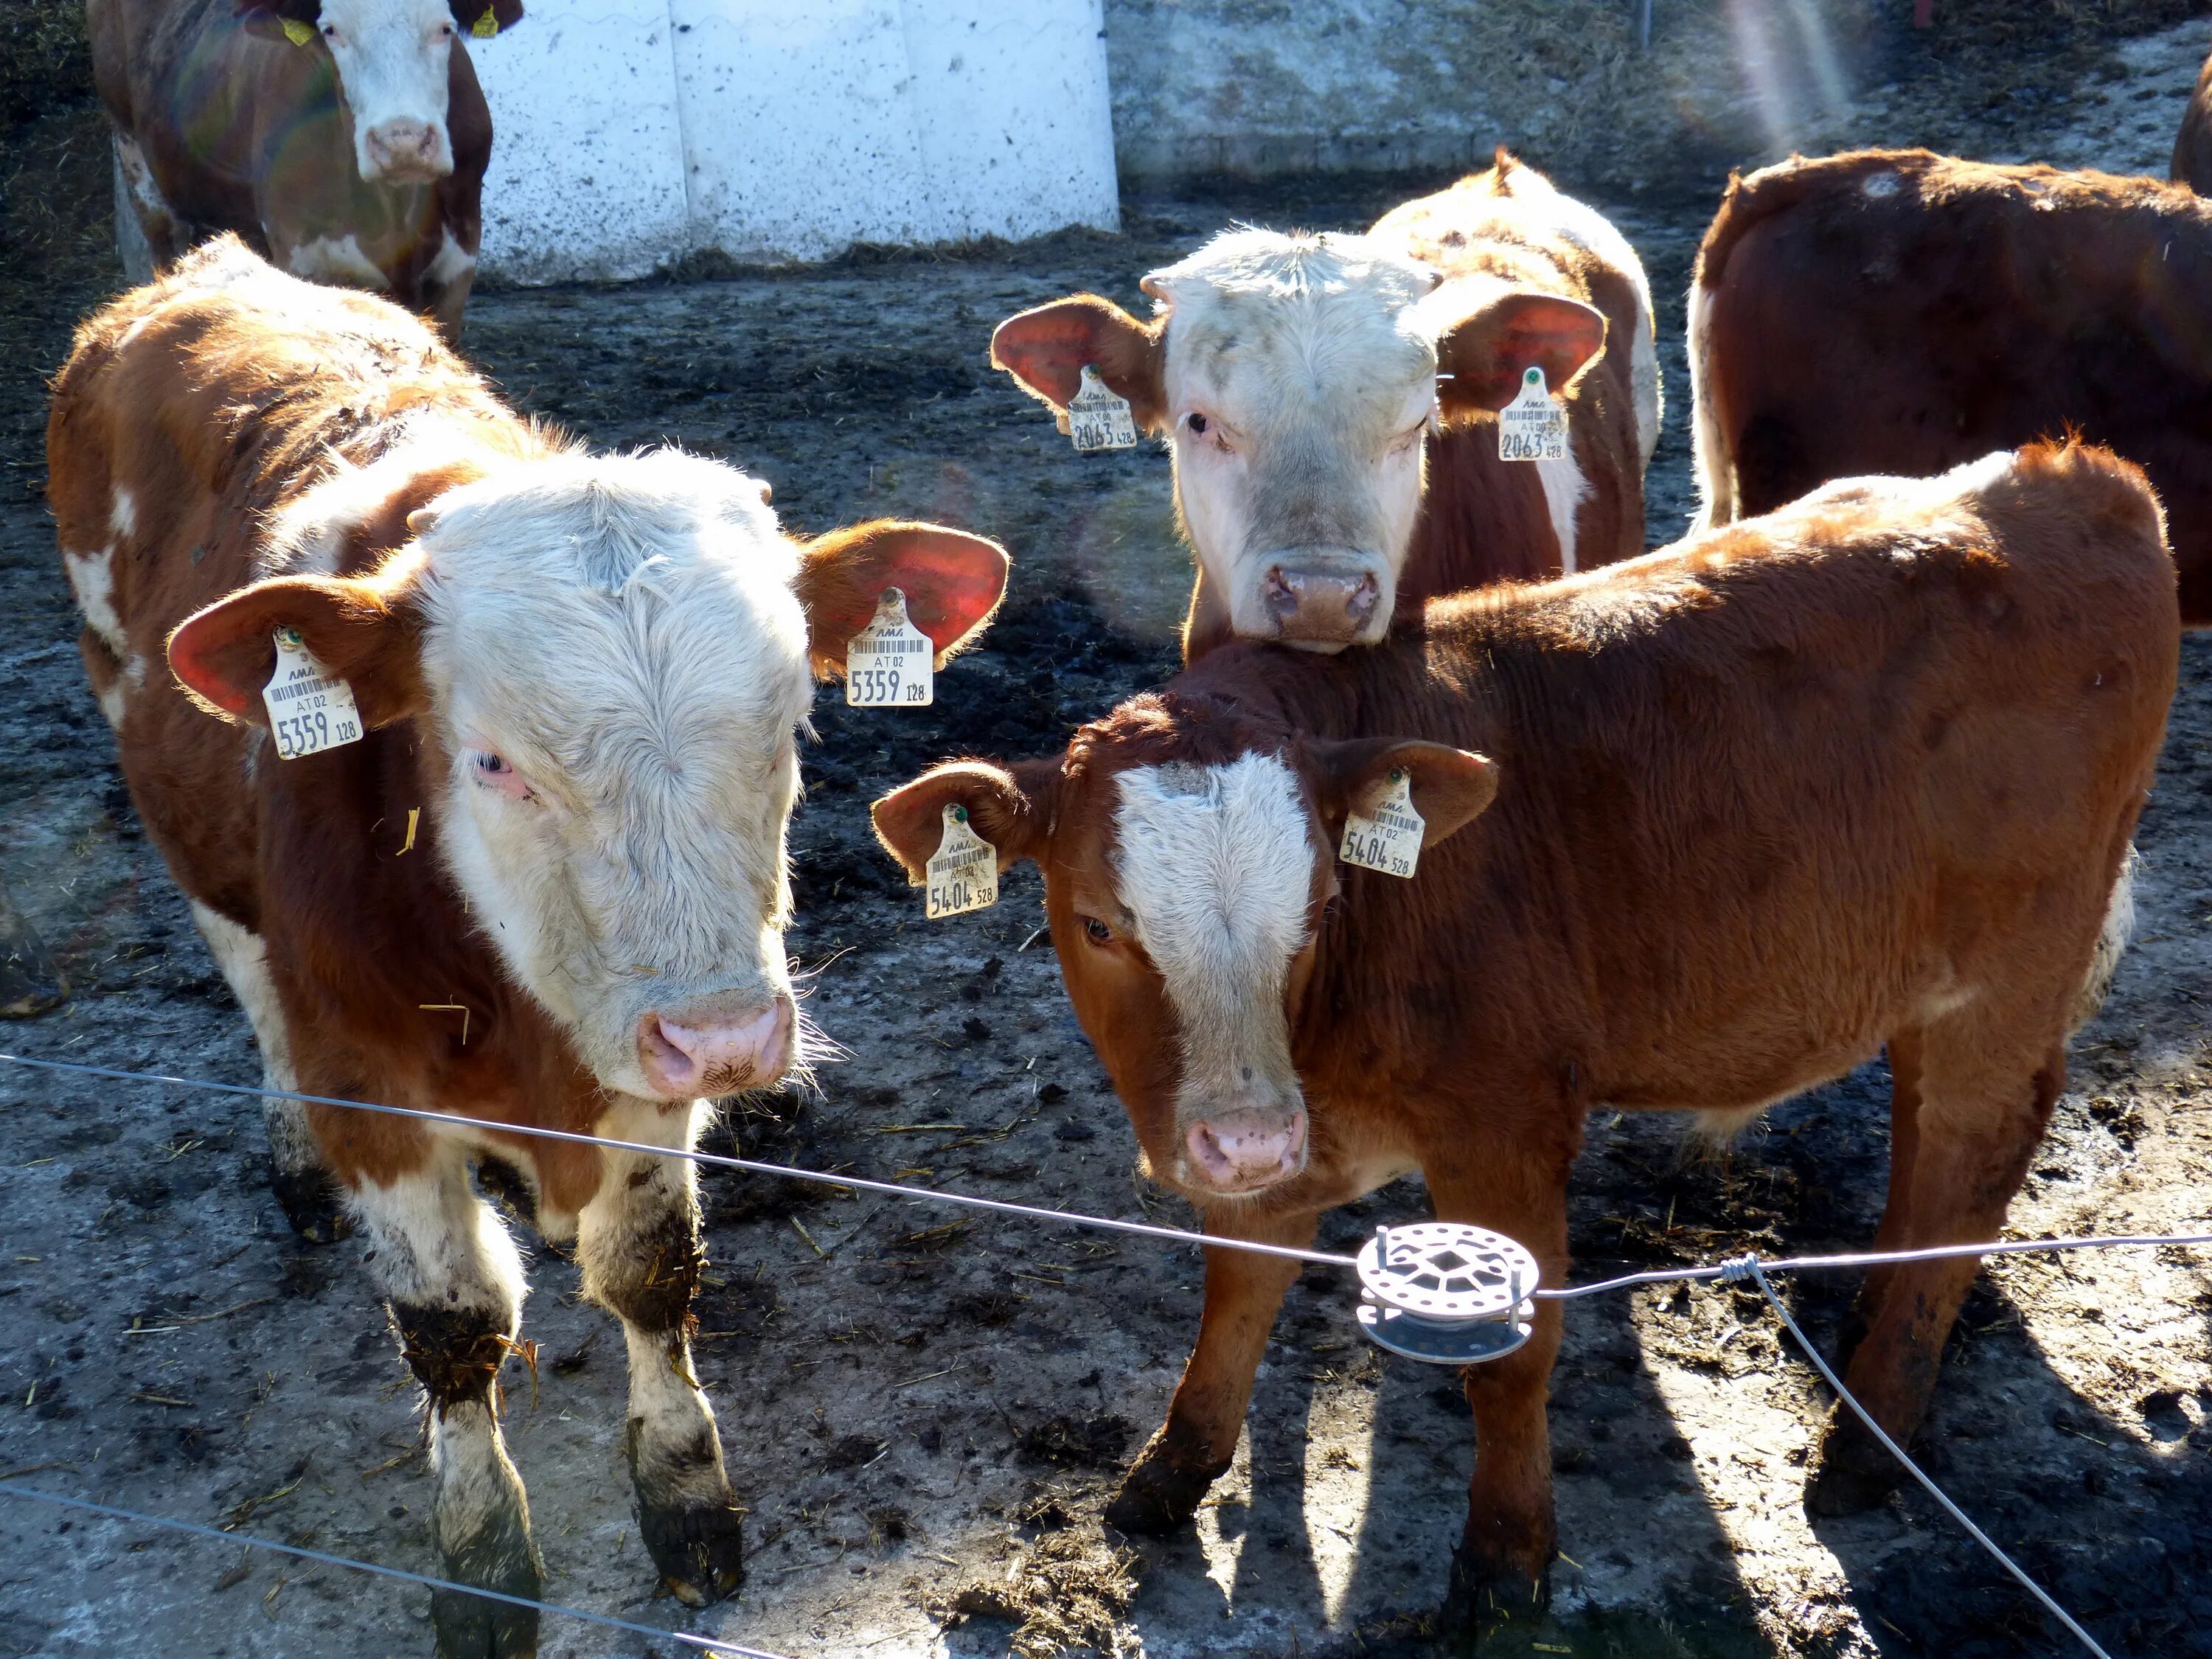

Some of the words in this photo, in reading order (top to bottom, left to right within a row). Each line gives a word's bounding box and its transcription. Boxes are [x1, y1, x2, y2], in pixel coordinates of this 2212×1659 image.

[1075, 422, 1113, 448] 2063
[1503, 434, 1542, 458] 2063
[874, 656, 891, 667] AT
[894, 656, 903, 667] 02
[852, 670, 900, 702] 5359
[907, 684, 925, 701] 128
[296, 698, 312, 713] AT
[315, 695, 327, 708] 02
[278, 712, 327, 755] 5359
[336, 721, 356, 741] 128
[1369, 824, 1386, 836] AT
[1386, 829, 1398, 840] 02
[1344, 831, 1387, 868] 5404
[1391, 858, 1409, 874] 528
[932, 881, 972, 915] 5404
[977, 888, 992, 905] 528
